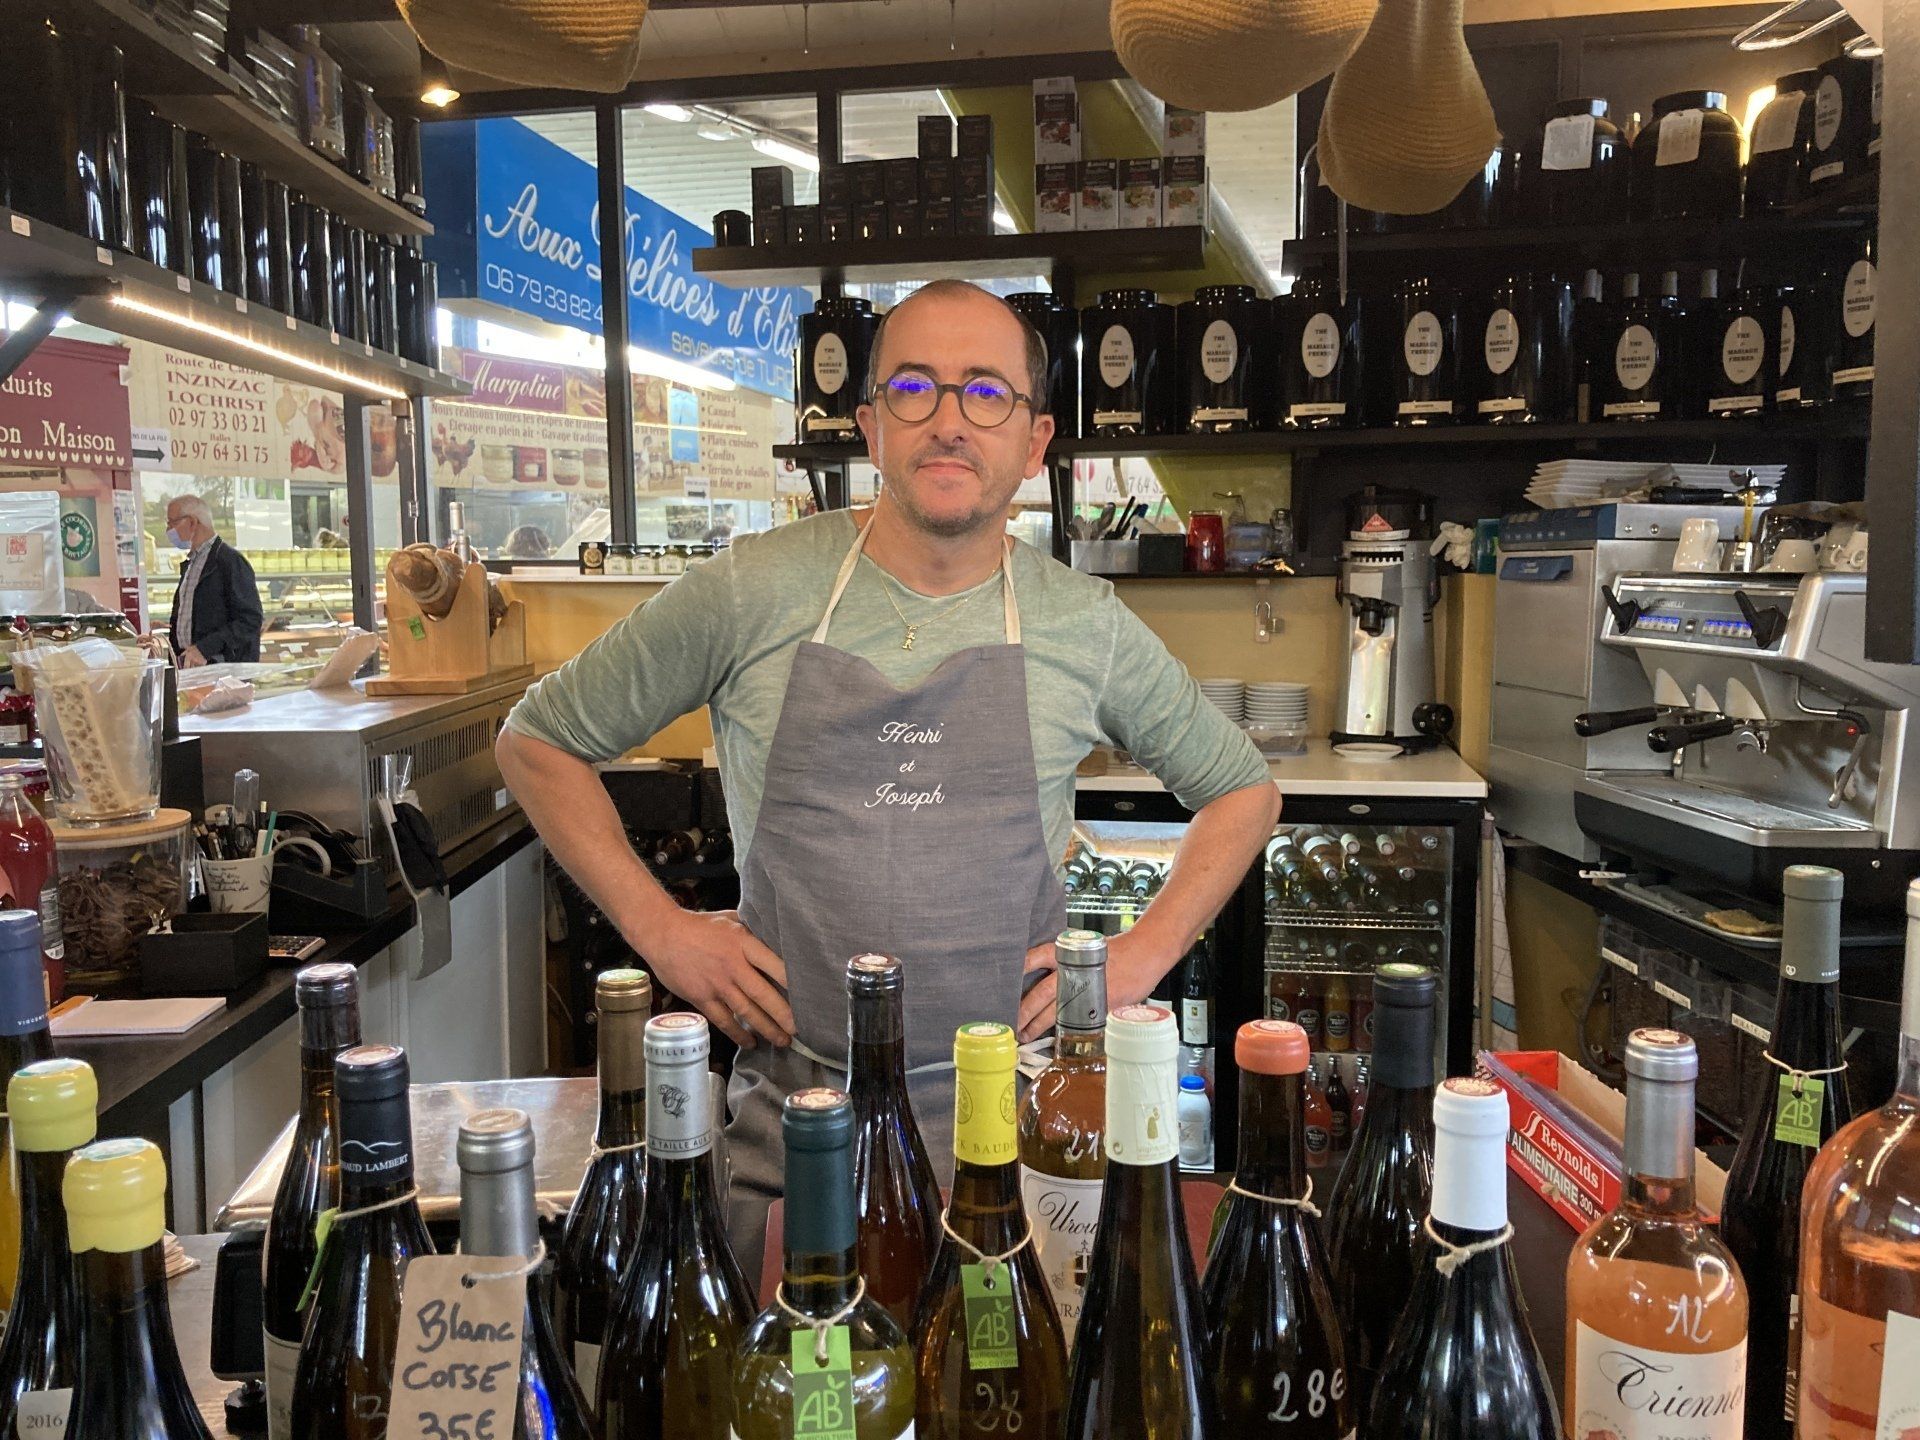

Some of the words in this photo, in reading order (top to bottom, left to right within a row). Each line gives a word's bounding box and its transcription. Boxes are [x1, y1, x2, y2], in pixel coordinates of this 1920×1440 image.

[484, 183, 583, 271] Aux
[486, 263, 514, 294] 06
[516, 274, 542, 304] 79
[544, 286, 568, 311] 33
[570, 295, 592, 322] 82
[165, 353, 203, 368] Route
[209, 359, 224, 373] de
[167, 371, 267, 394] INZINZAC
[168, 391, 266, 412] LOCHRIST
[169, 407, 186, 425] 02
[190, 411, 206, 429] 97
[212, 414, 228, 431] 33
[232, 416, 248, 432] 03
[252, 417, 267, 433] 21
[41, 420, 116, 452] Maison
[171, 440, 187, 458] 02
[192, 442, 208, 460] 97
[213, 443, 229, 460] 64
[233, 445, 248, 462] 51
[253, 447, 269, 464] 75
[878, 721, 945, 744] Henri
[899, 759, 917, 773] et
[864, 782, 946, 813] Joseph
[1779, 1099, 1814, 1128] AB
[660, 1140, 690, 1150] TAILLE
[1541, 1123, 1600, 1190] Reynolds
[365, 1153, 409, 1173] LAMBERT
[1511, 1131, 1579, 1206] ALIMENTAIRE
[1579, 1193, 1595, 1217] 300
[416, 1299, 516, 1353] Blanc
[972, 1311, 1010, 1348] AB
[26, 1413, 63, 1430] 2016
[418, 1408, 497, 1440] 35€
[797, 1389, 843, 1431] AB
